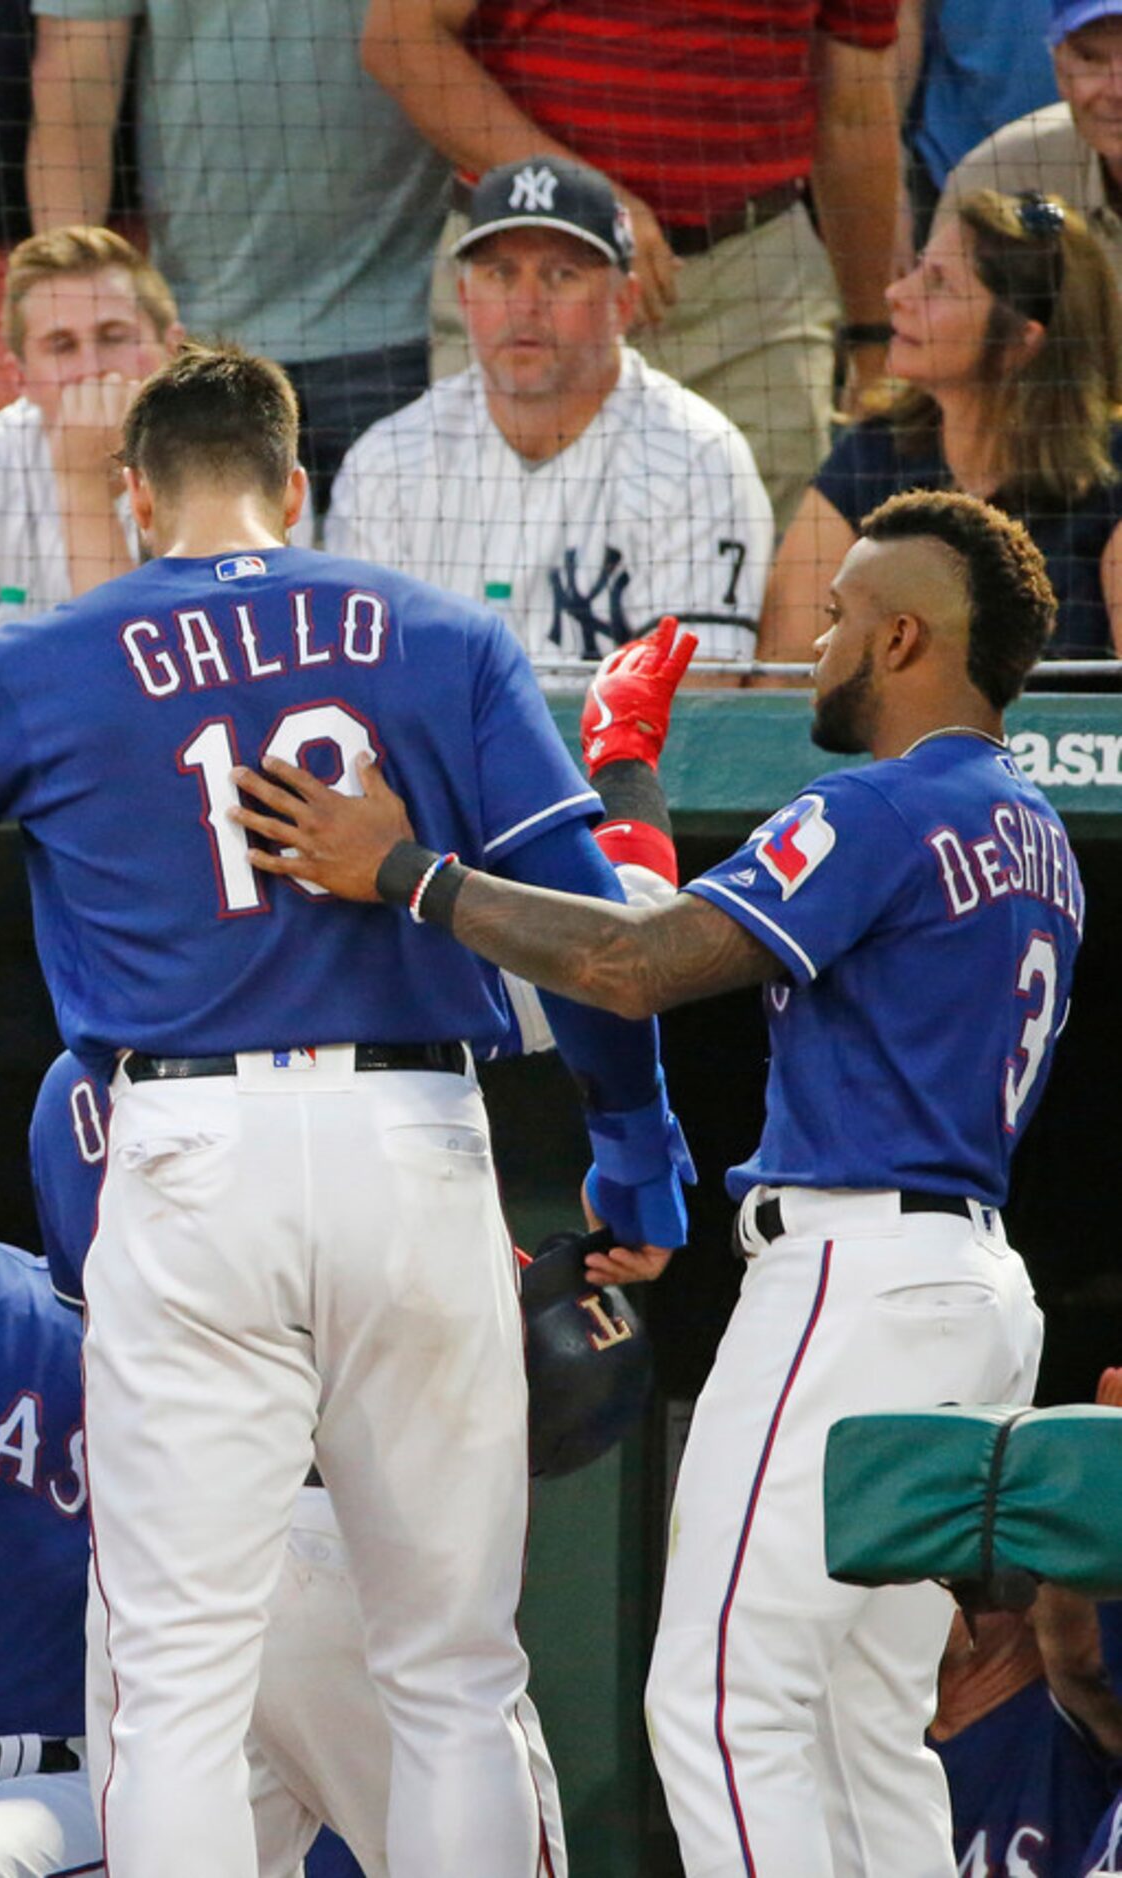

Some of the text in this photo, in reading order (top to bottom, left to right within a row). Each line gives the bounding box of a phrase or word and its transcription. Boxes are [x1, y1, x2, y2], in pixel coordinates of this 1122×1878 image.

[508, 165, 559, 211] NY
[547, 546, 632, 661] NY
[718, 540, 746, 604] 7
[118, 589, 389, 699] GALLO
[1002, 929, 1058, 1132] 3
[577, 1293, 633, 1352] T
